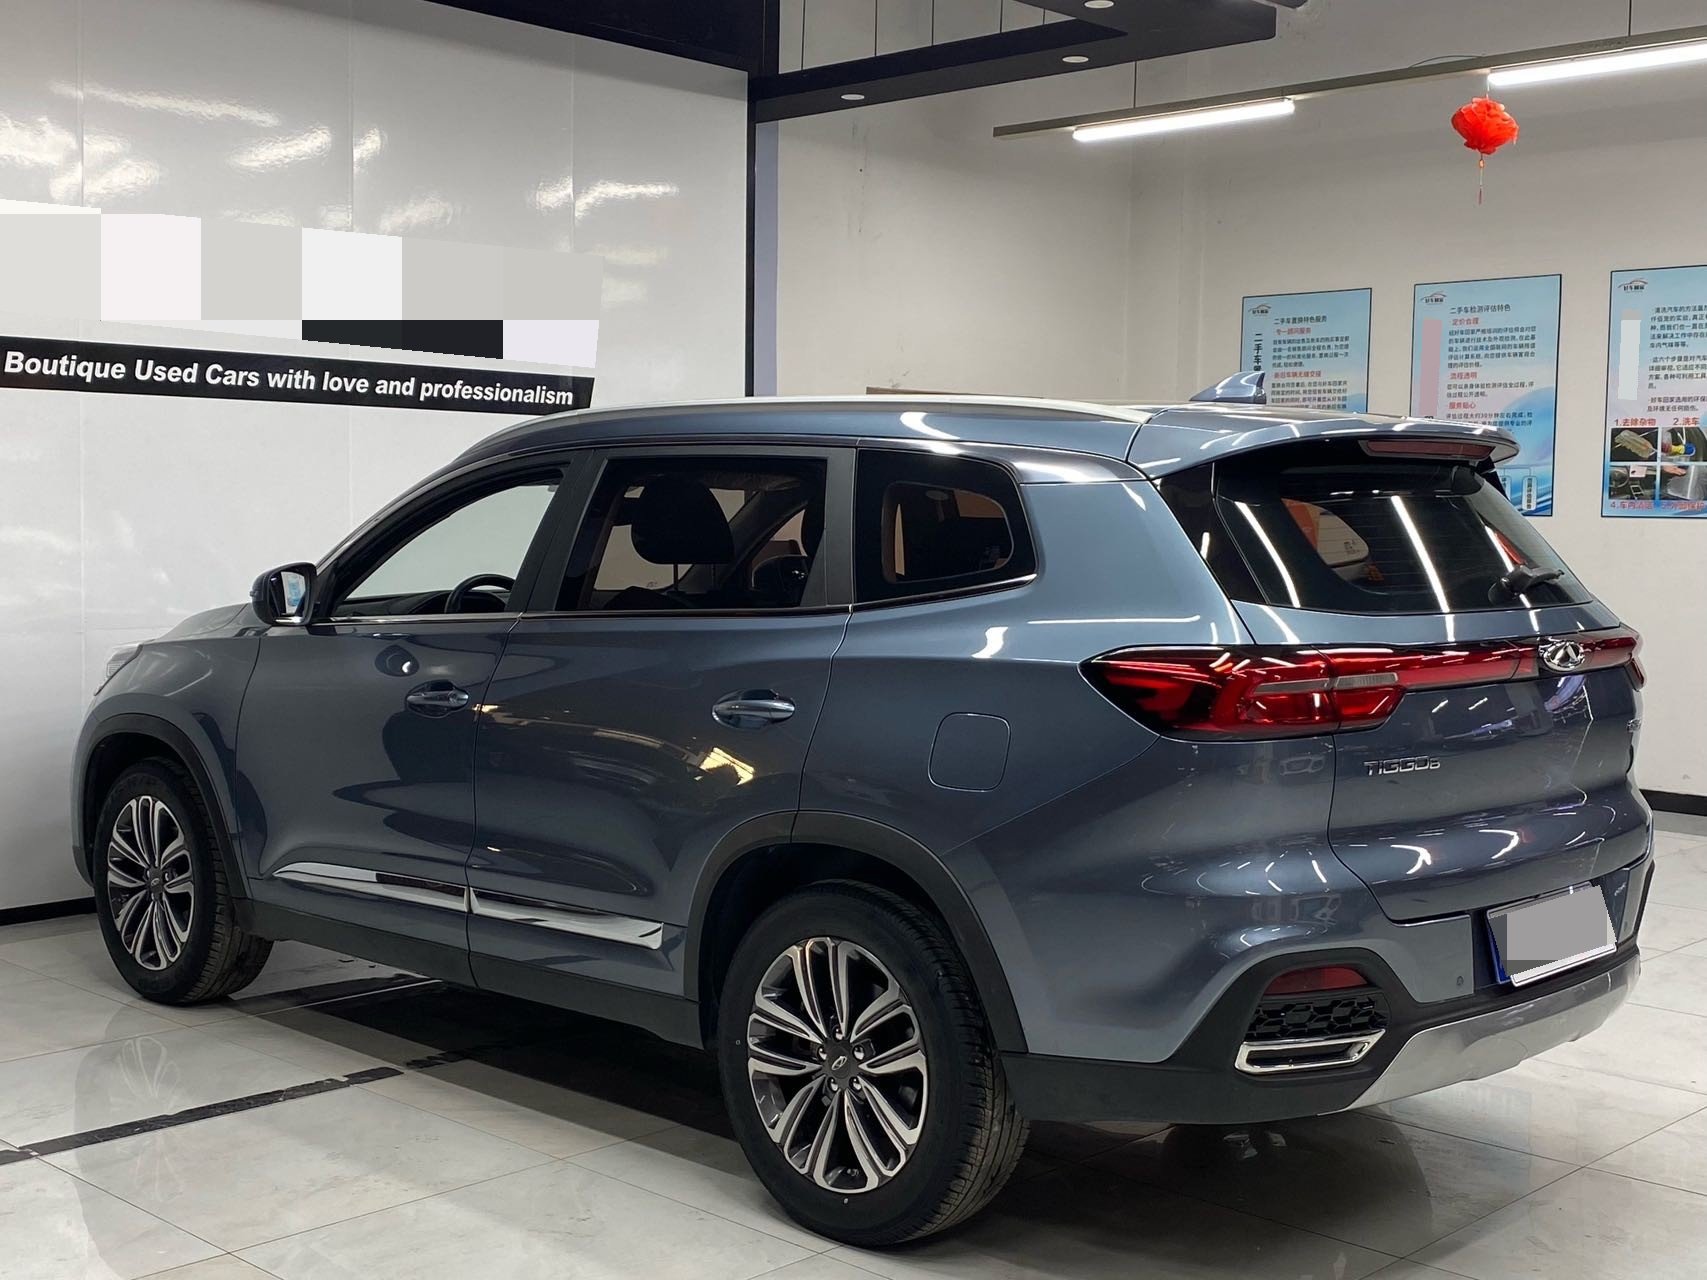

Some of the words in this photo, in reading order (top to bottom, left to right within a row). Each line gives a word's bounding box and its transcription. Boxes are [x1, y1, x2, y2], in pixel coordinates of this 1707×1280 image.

[1449, 303, 1511, 315] 二手车检测评估特色
[1451, 317, 1480, 326] 定价合理
[4, 351, 126, 383] Boutique
[134, 359, 199, 383] Used
[205, 363, 260, 387] Cars
[267, 369, 315, 390] with
[322, 371, 369, 393] love
[375, 377, 415, 396] and
[419, 379, 574, 405] professionalism
[1450, 371, 1478, 380] 流程透明
